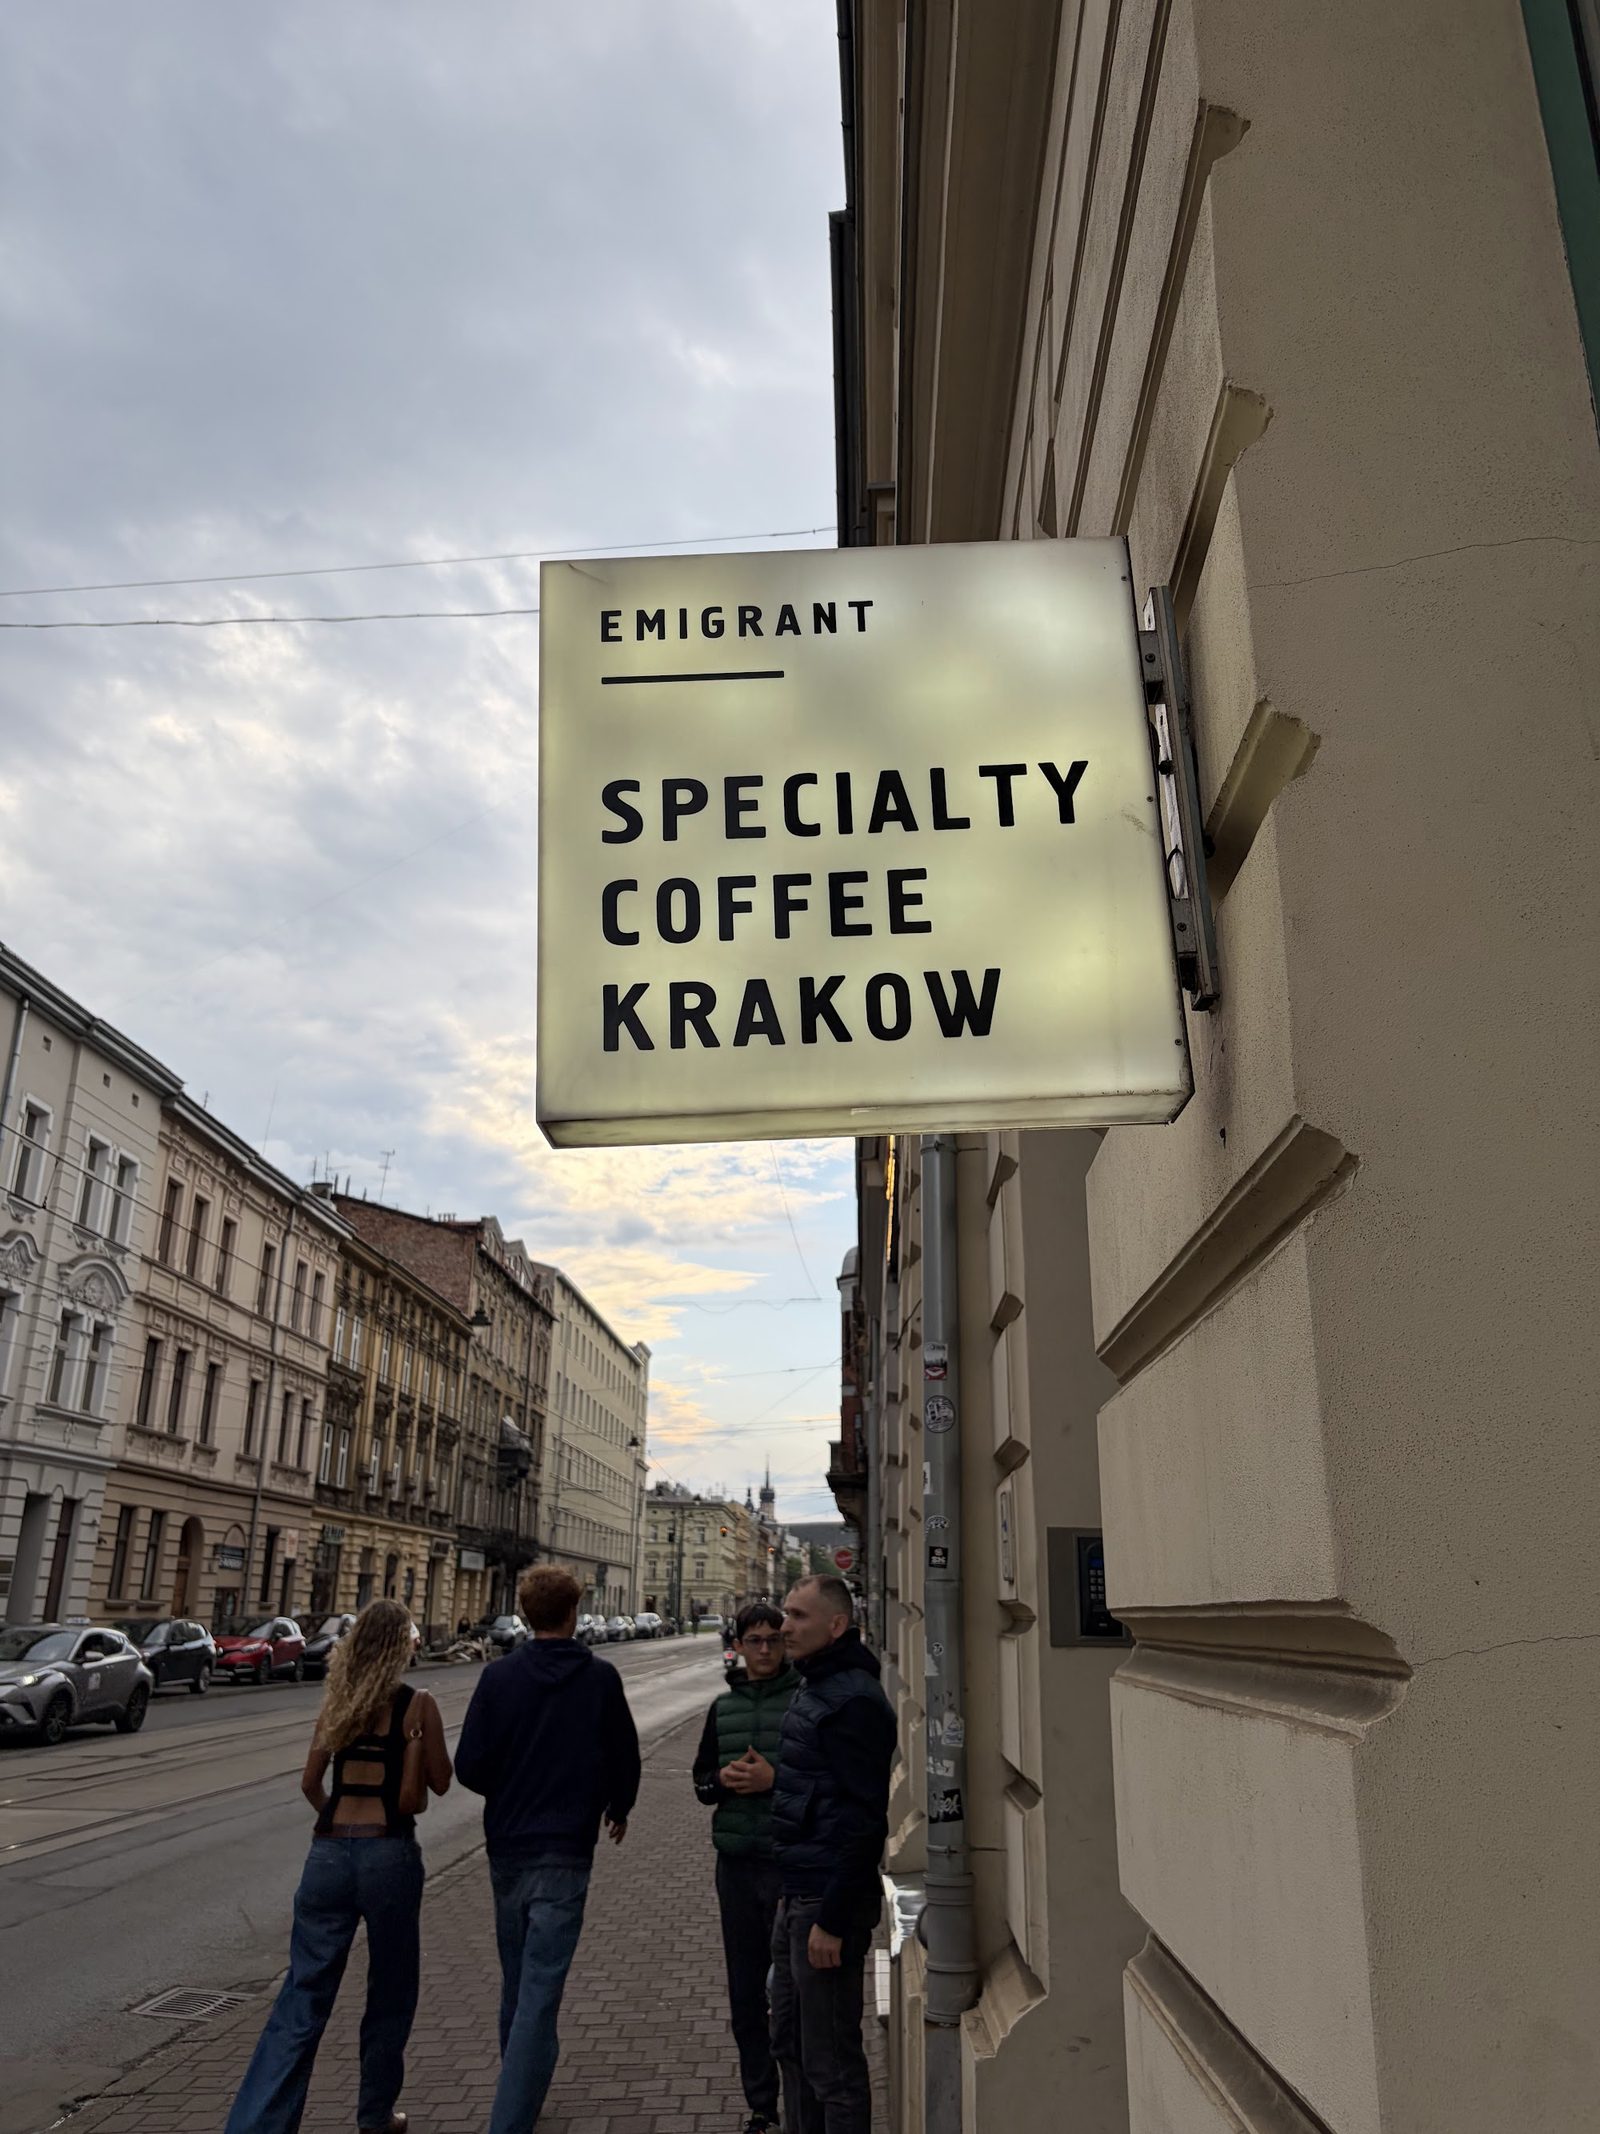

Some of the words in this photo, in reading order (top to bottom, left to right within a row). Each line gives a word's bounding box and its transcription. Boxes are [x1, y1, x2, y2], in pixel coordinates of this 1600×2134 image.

[601, 601, 874, 643] EMIGRANT
[602, 760, 1089, 844] SPECIALTY
[602, 868, 932, 946] COFFEE
[603, 968, 1001, 1052] KRAKOW
